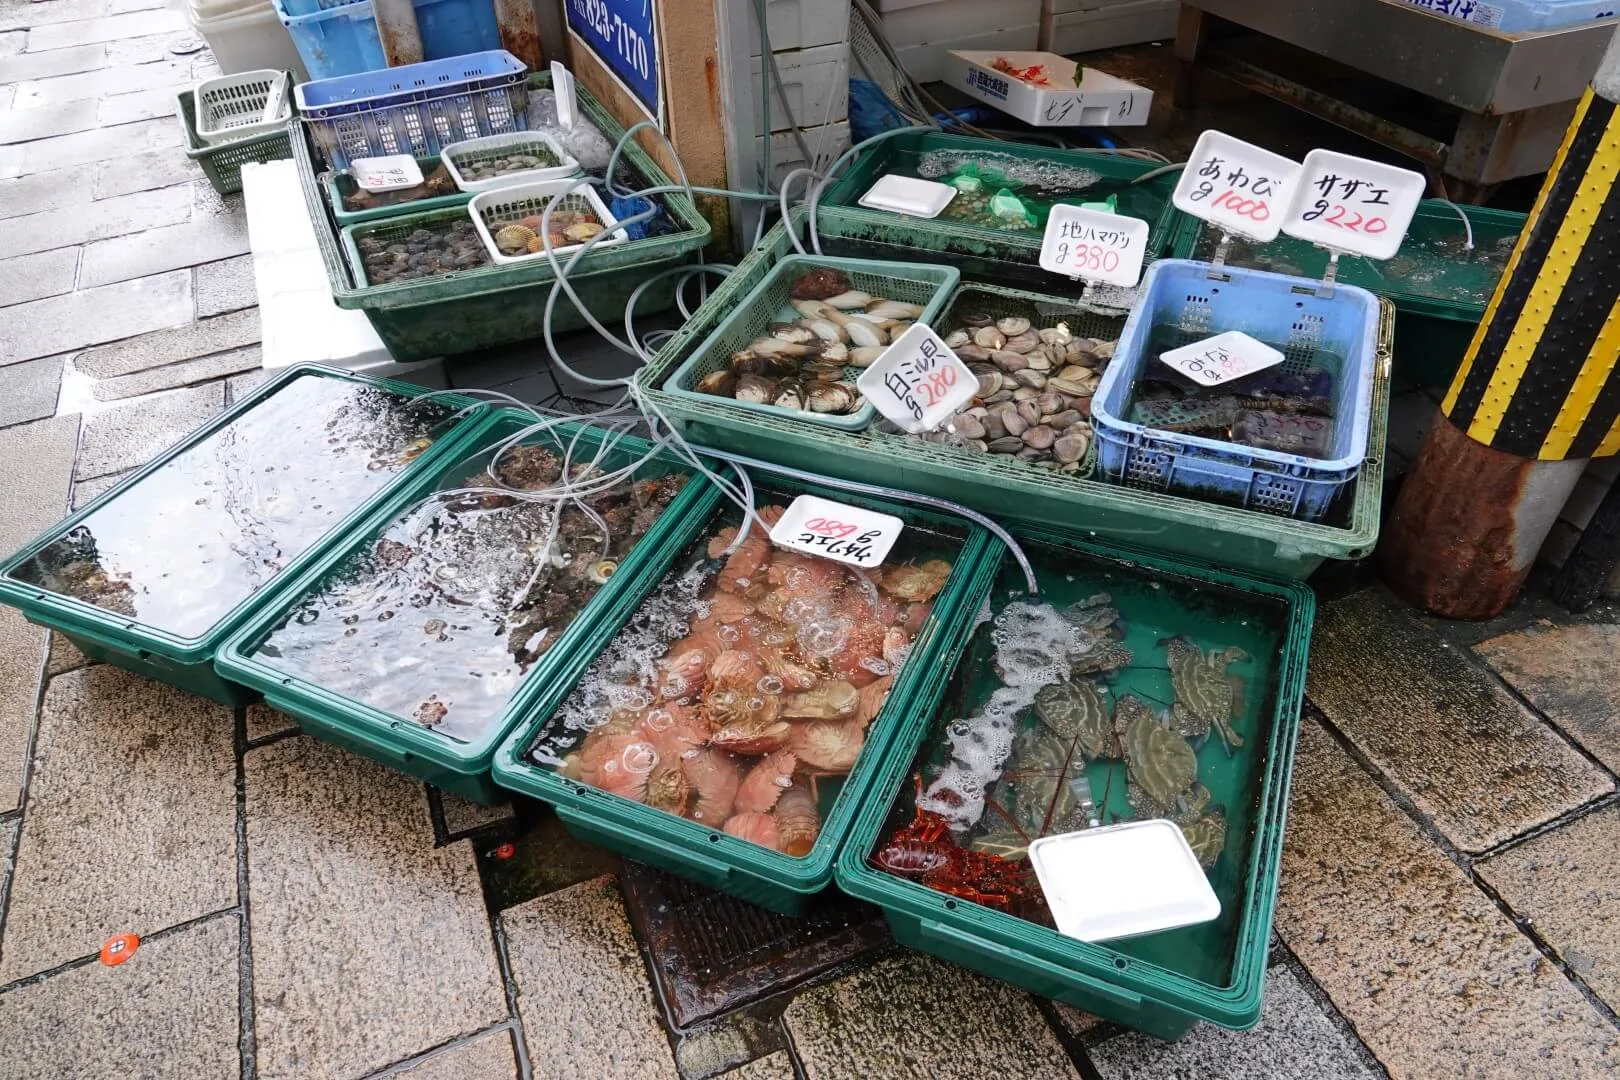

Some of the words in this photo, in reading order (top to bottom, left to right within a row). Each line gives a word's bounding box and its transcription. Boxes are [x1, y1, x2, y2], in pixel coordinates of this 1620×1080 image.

[585, 0, 649, 81] 823-7170
[1199, 157, 1282, 198] あわび
[1313, 174, 1390, 206] サザエ
[1060, 219, 1130, 250] 地ハマグリ
[884, 337, 948, 401] 白ミル貝
